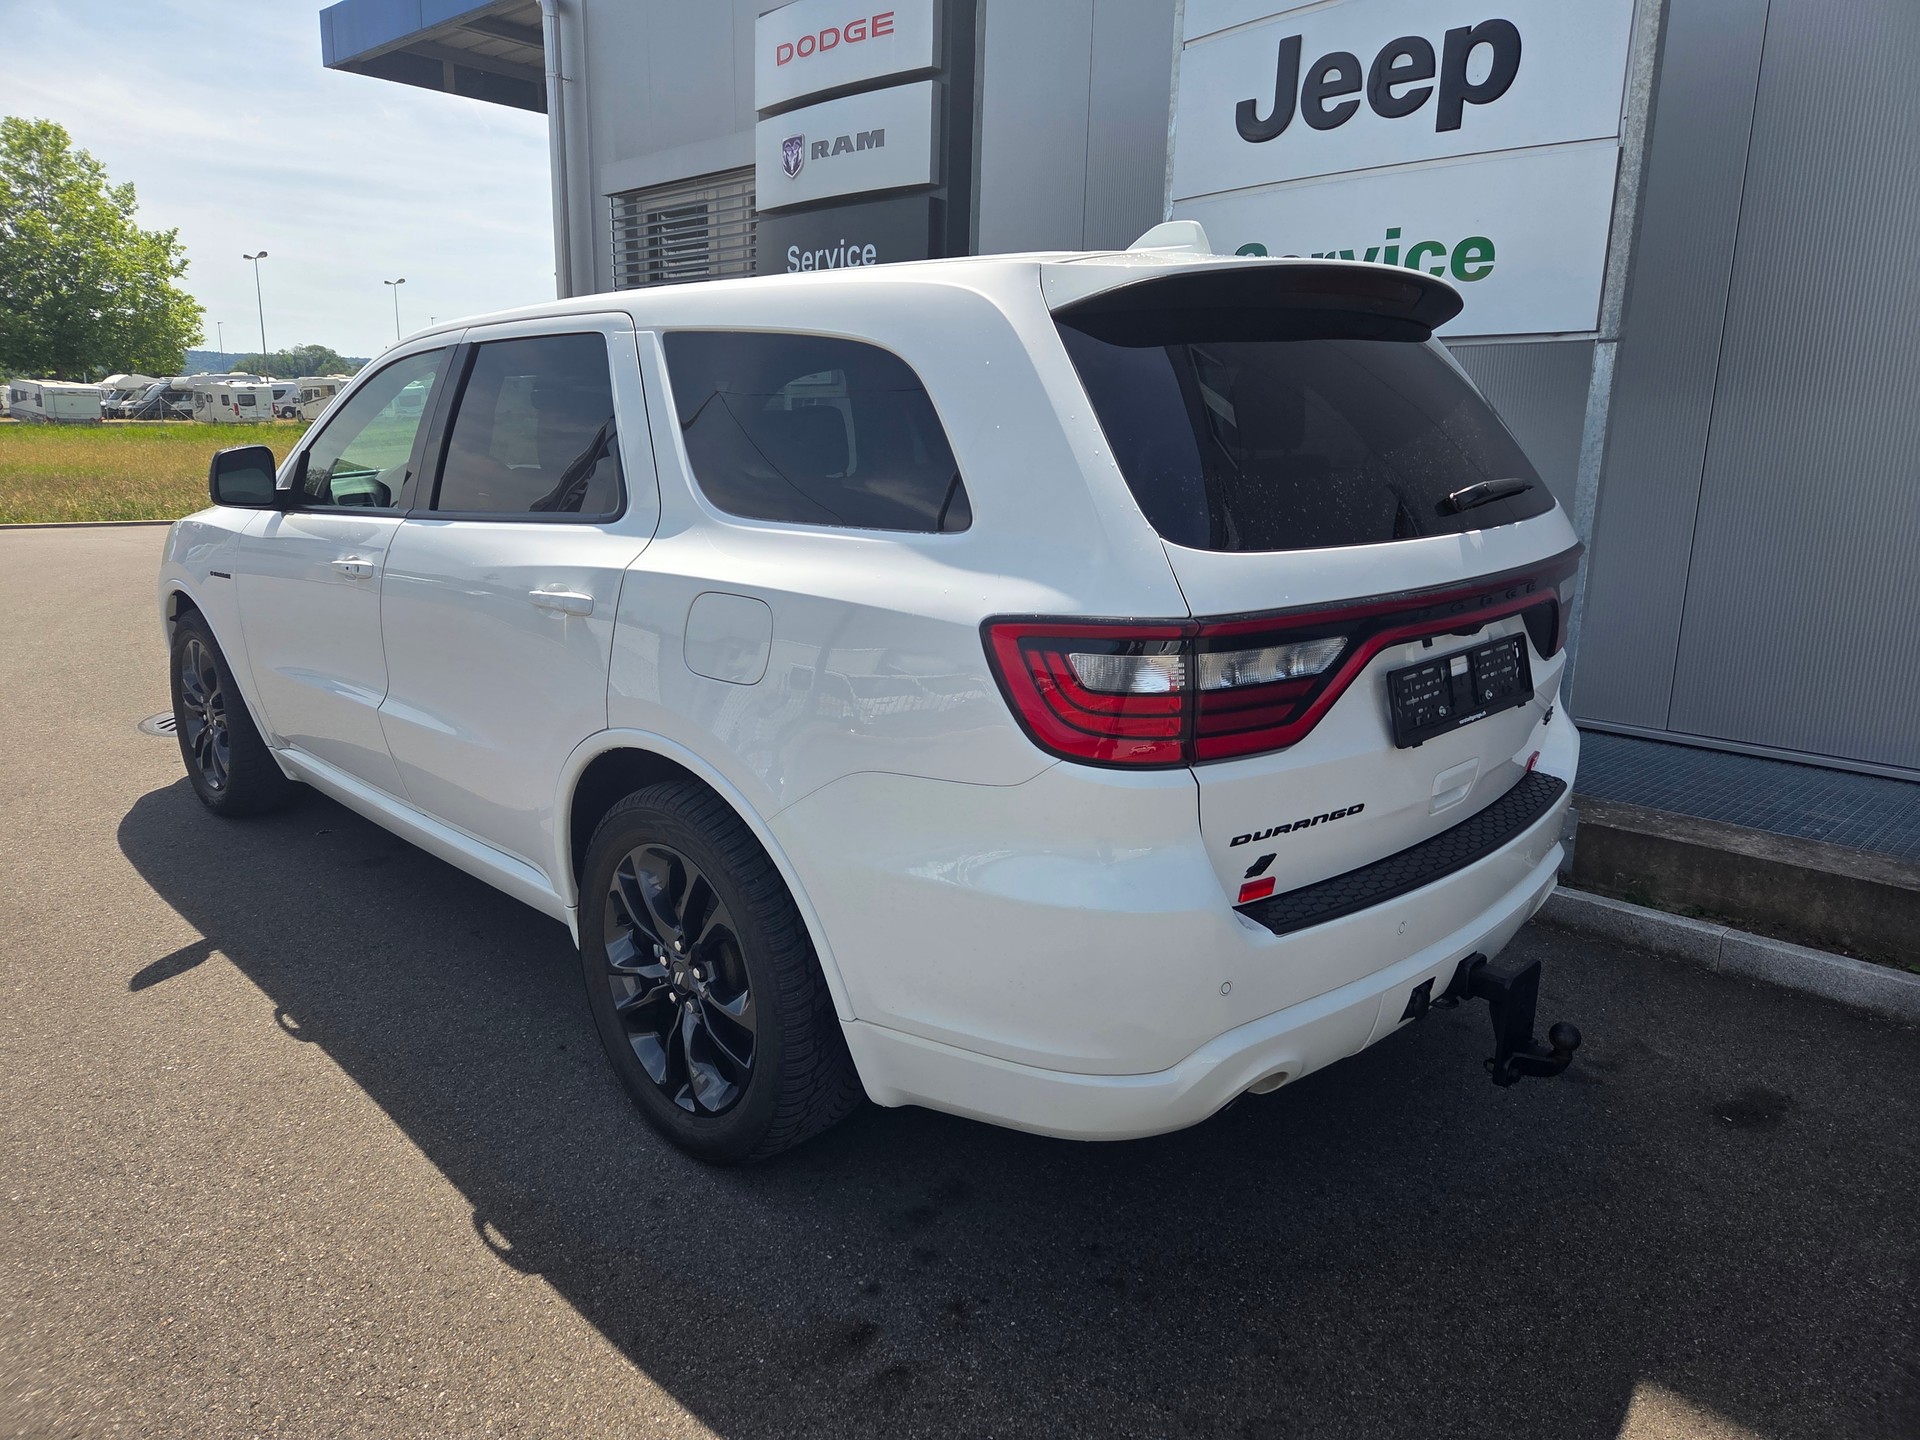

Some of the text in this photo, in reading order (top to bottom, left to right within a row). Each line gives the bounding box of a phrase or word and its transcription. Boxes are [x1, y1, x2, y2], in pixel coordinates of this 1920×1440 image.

[777, 11, 895, 66] DODGE
[1235, 18, 1522, 143] Jeep
[811, 128, 885, 160] RAM
[787, 239, 877, 273] Service
[1229, 803, 1365, 847] DURANGO
